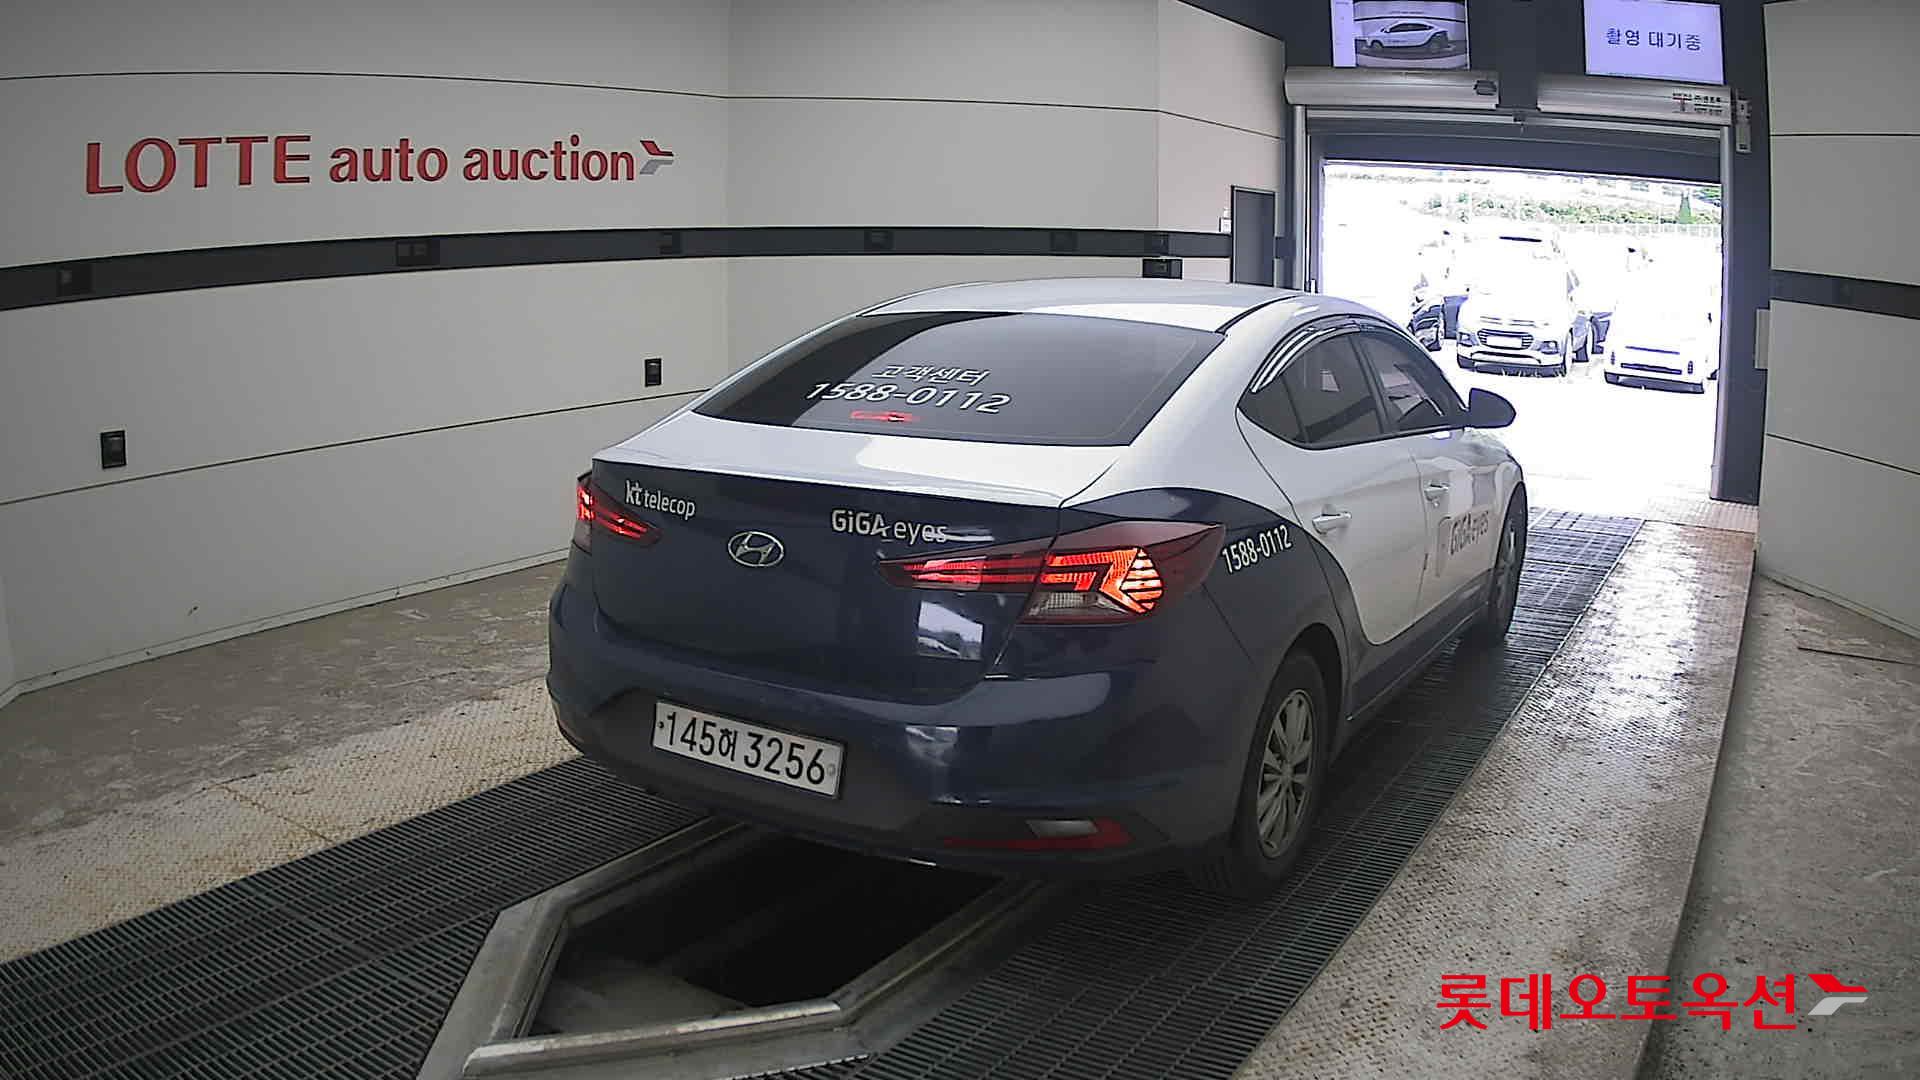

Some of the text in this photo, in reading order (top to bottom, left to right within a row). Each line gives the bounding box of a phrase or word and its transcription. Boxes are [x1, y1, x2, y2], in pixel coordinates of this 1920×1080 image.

[1648, 30, 1701, 51] 대기중
[86, 134, 634, 194] LOTTE auto auction
[871, 365, 990, 386] 고객센터
[806, 382, 1011, 414] 1588-0112
[626, 480, 695, 520] kt telecop
[894, 521, 947, 545] eyes
[1222, 524, 1292, 573] 1588-0112
[667, 711, 825, 785] 145허 3256
